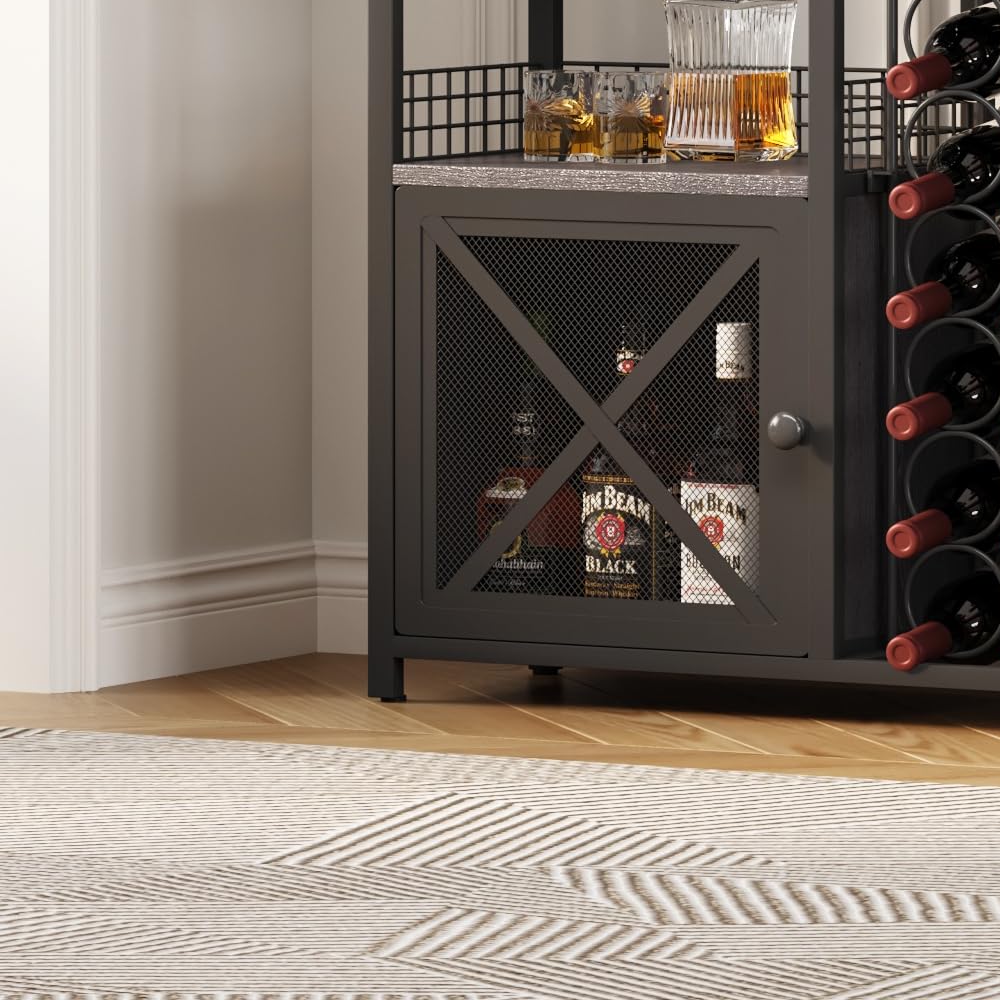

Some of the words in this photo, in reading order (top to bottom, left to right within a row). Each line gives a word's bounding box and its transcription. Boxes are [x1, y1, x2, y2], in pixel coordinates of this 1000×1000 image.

[581, 490, 603, 523] JIM
[604, 485, 651, 526] BEAM
[706, 492, 747, 525] BEAM
[584, 554, 637, 575] BLACK
